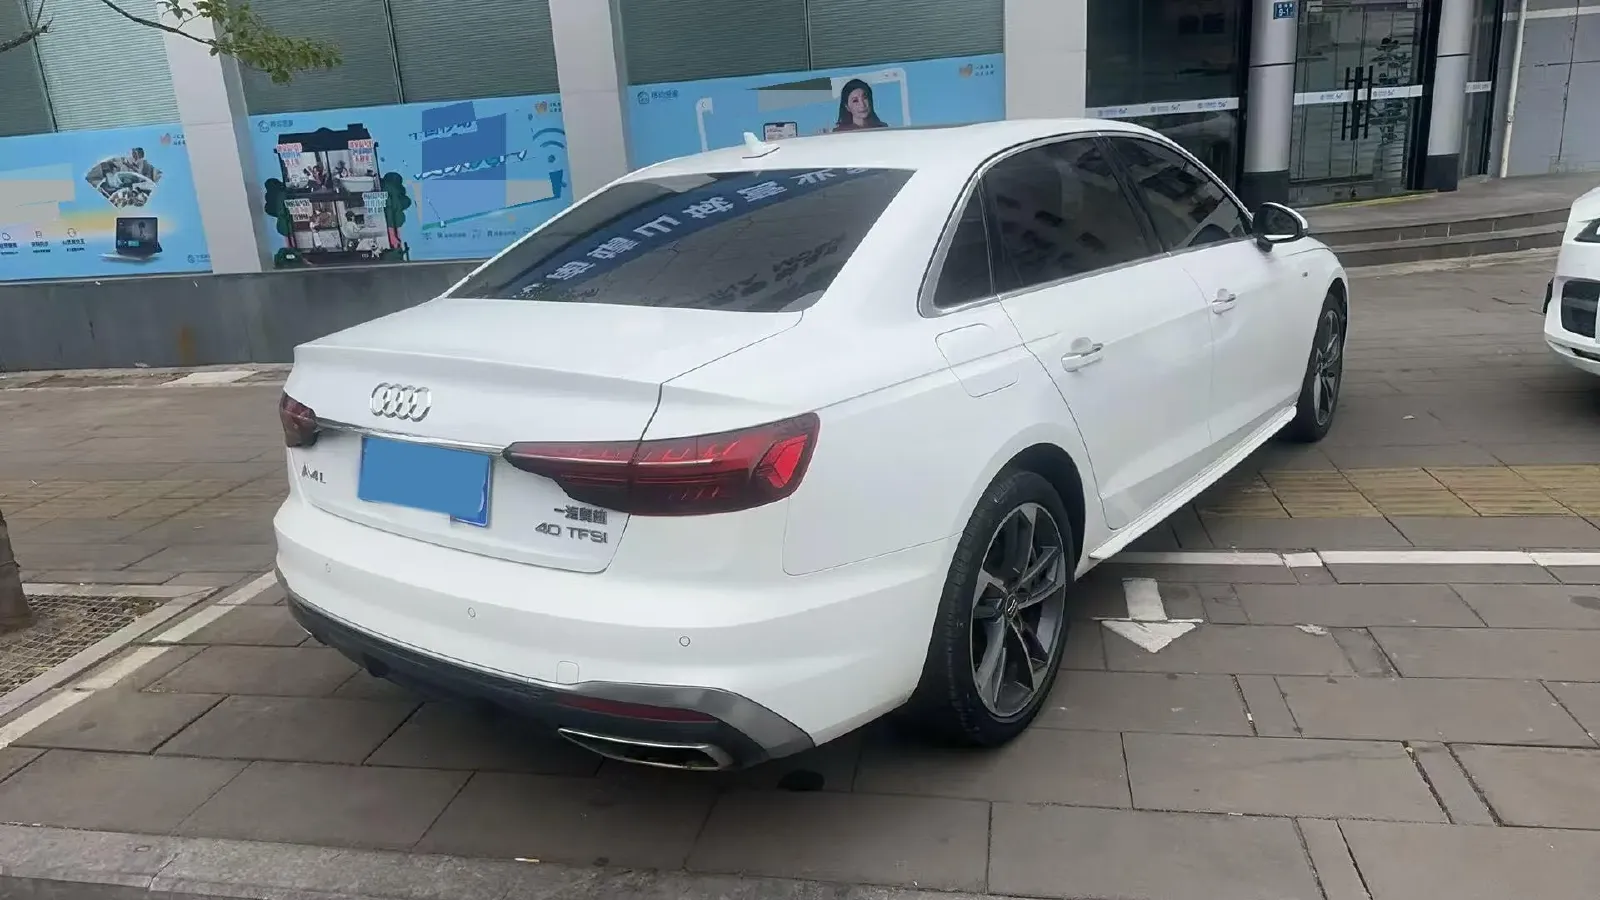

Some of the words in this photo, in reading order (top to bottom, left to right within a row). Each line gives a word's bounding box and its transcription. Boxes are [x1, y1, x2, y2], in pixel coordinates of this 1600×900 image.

[301, 463, 327, 484] A4L
[535, 522, 562, 537] 40
[566, 526, 608, 544] TFSI
